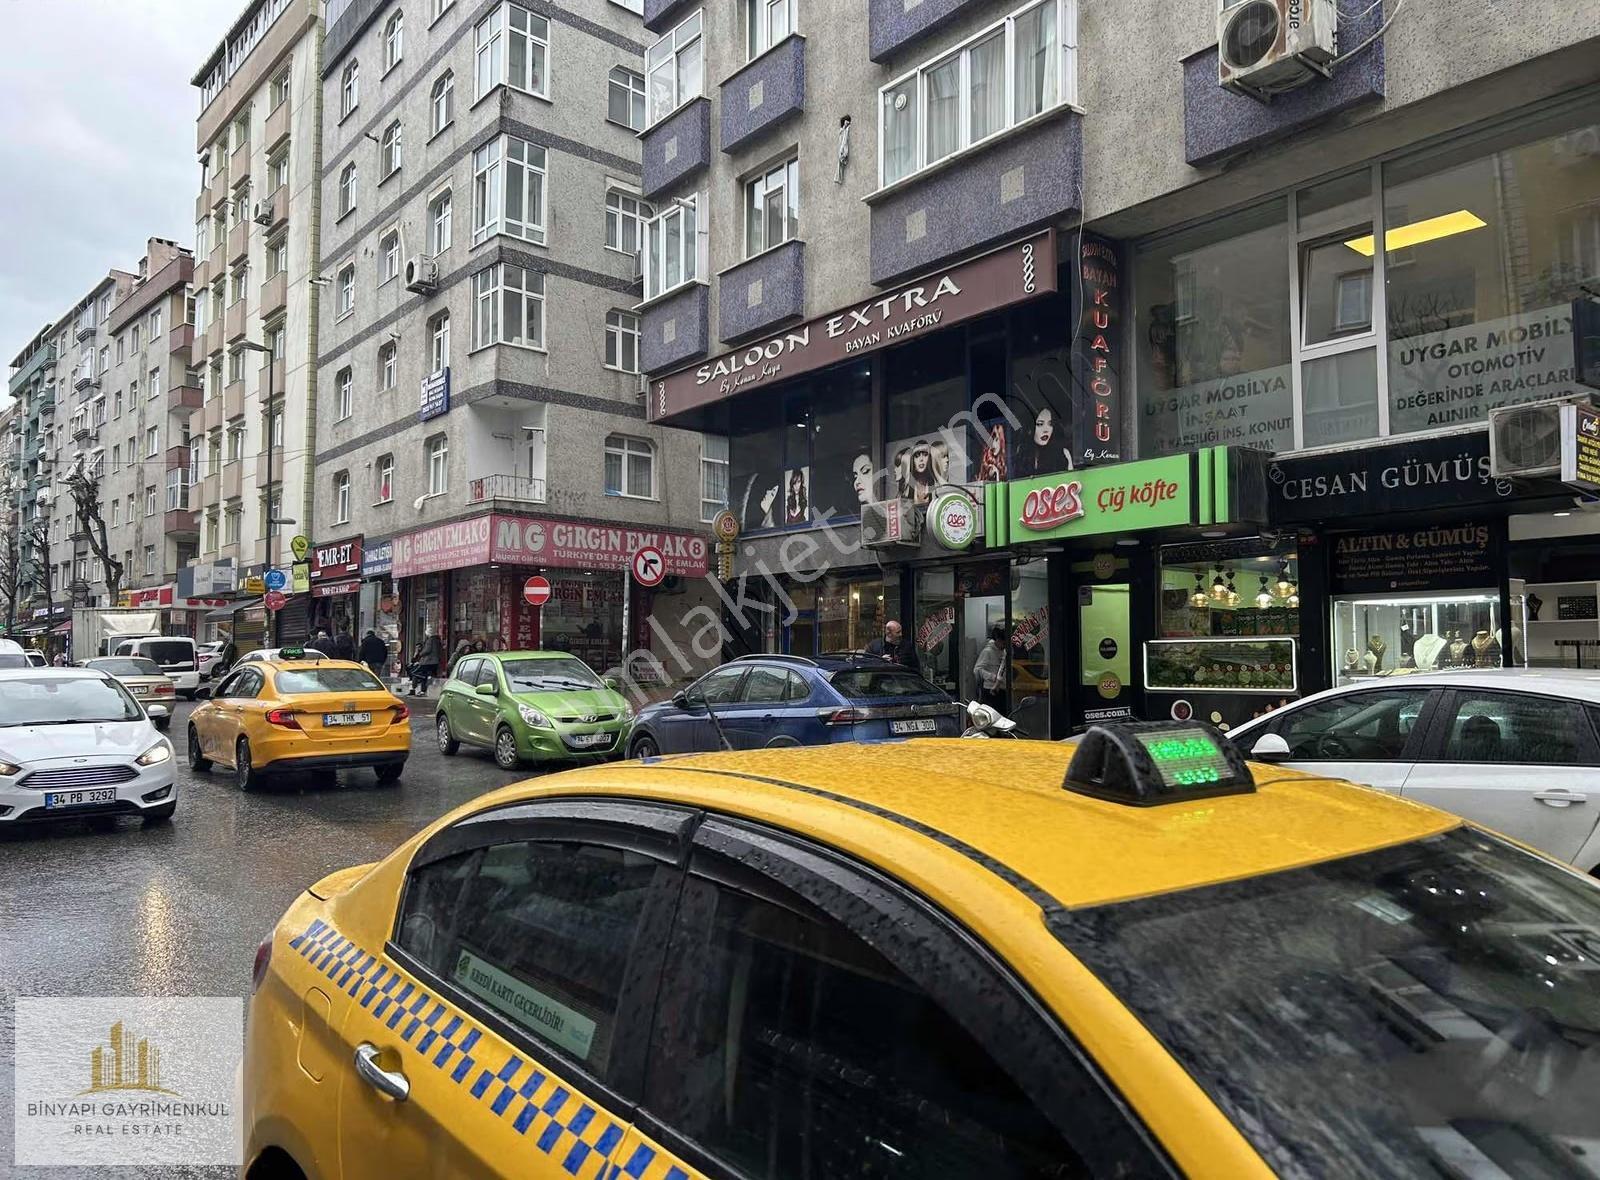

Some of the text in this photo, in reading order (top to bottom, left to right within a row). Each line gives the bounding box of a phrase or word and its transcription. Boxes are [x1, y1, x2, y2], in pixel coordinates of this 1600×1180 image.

[696, 275, 963, 385] SALOON EXTRA
[845, 331, 881, 353] BAYAN
[1399, 315, 1575, 367] UYGAR MOBİLY
[1447, 345, 1546, 379] OTOMOTİV
[719, 378, 731, 394] By
[1145, 375, 1287, 417] UYGAR MOBİLYA
[1396, 383, 1484, 411] DEĞERİNDE
[1249, 416, 1293, 434] KONUT
[1426, 404, 1484, 426] ALINIR
[1083, 448, 1095, 461] By
[1380, 452, 1491, 489] GÜMÜŞ
[1097, 486, 1126, 513] Çiğ
[1130, 478, 1179, 508] köfte
[445, 521, 480, 549] EMLAK
[625, 531, 688, 558] EMLAK
[1335, 533, 1394, 554] ALTIN
[1396, 534, 1411, 550] &
[1412, 522, 1489, 549] GÜMÜŞ
[675, 561, 706, 569] EMLAK
[53, 790, 114, 805] 34 PB 3292
